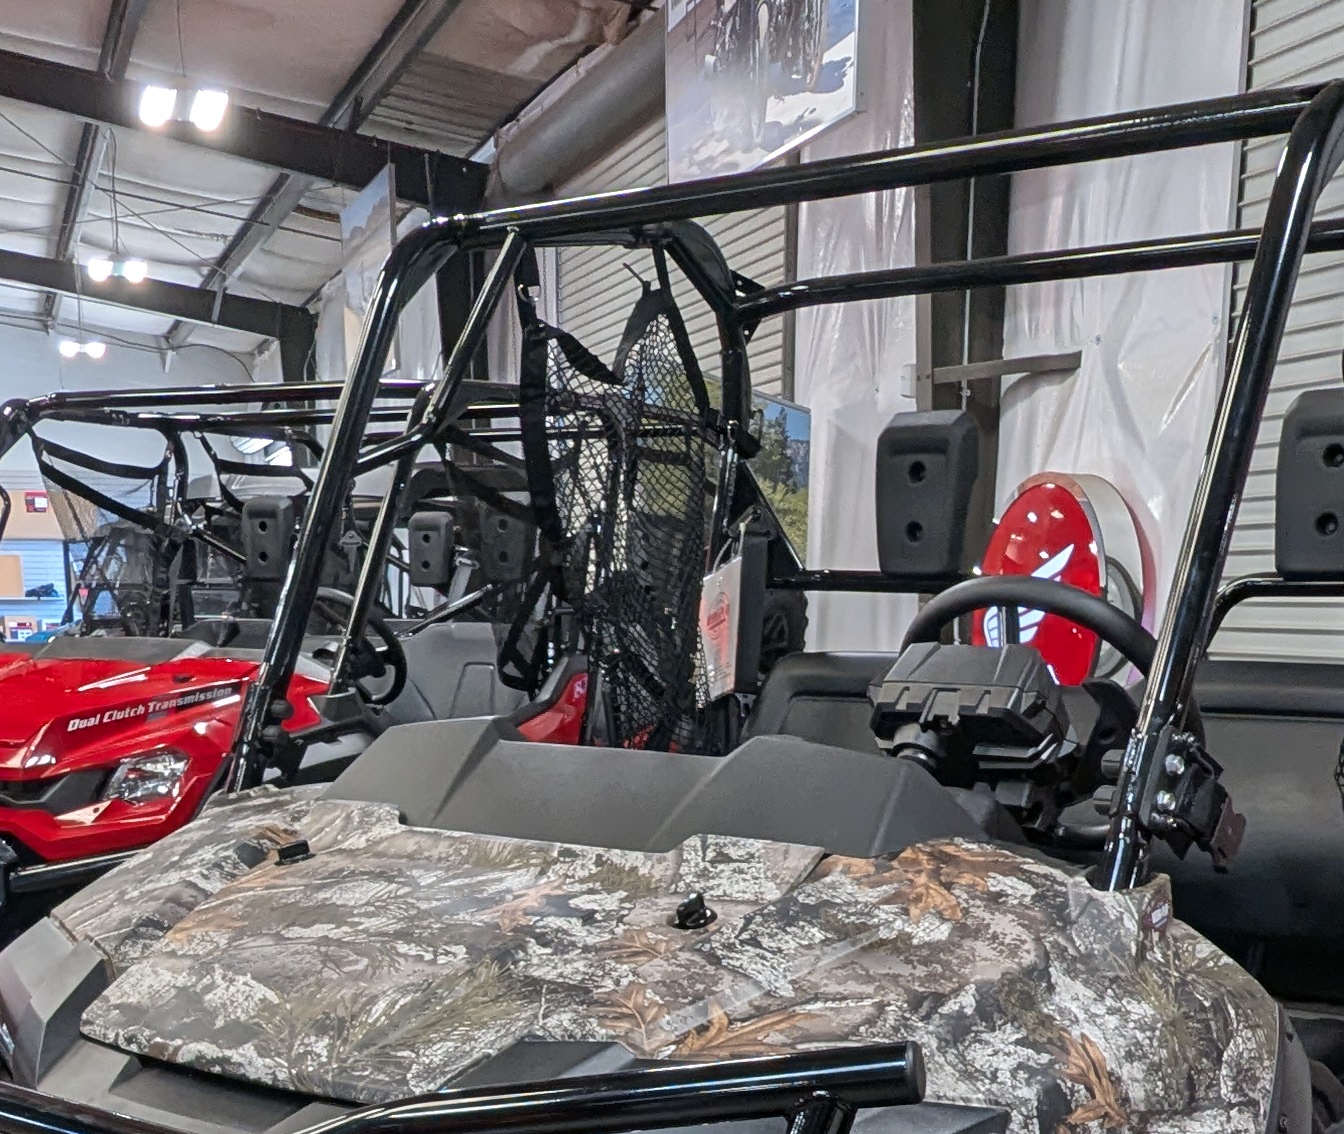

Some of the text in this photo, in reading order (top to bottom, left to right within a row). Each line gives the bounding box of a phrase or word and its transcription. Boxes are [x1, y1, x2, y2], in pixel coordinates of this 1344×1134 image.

[67, 685, 232, 732] Dual Clutch Transmission
